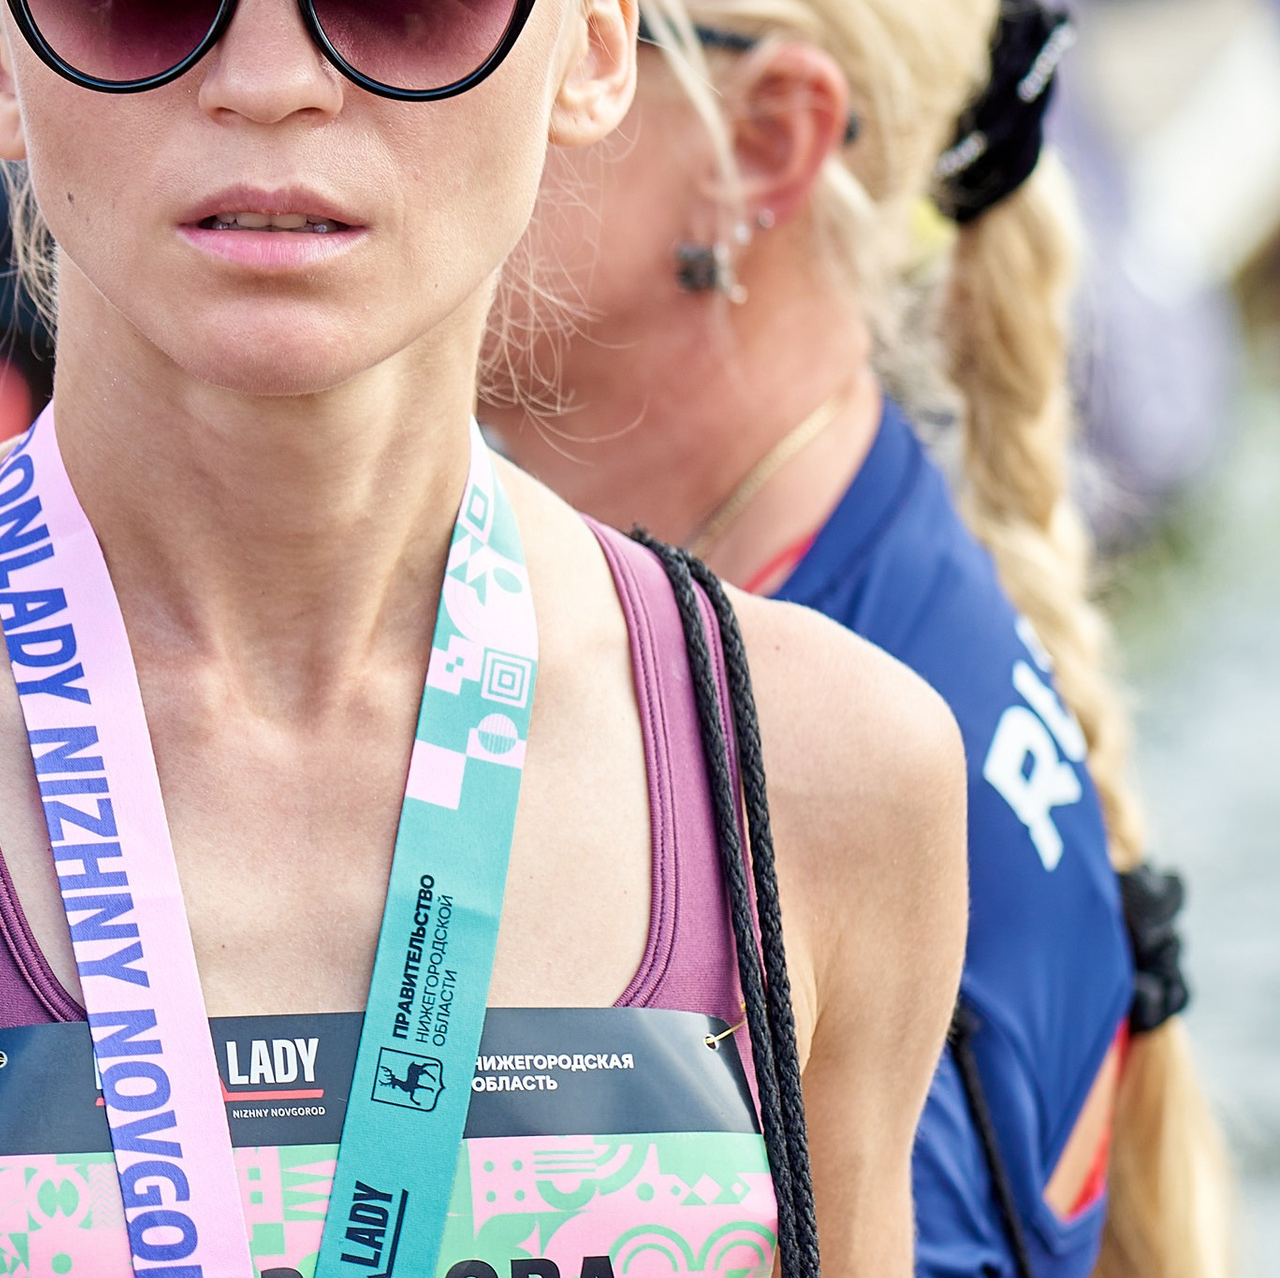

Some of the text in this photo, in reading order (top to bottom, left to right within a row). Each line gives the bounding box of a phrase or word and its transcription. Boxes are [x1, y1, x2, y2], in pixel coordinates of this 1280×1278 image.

[26, 724, 150, 989] NIZHNY
[392, 873, 435, 1040] ПРАВИТЕЛЬСТВО
[414, 893, 454, 1044] НИЖЕГОРОДСКОЙ
[432, 969, 458, 1047] ОБЛАСТИ
[225, 1037, 320, 1086] LADY
[471, 1074, 559, 1093] ОБЛАСТЬ
[232, 1106, 326, 1119] NIZHNY NOVGOROD
[339, 1180, 394, 1270] LADY
